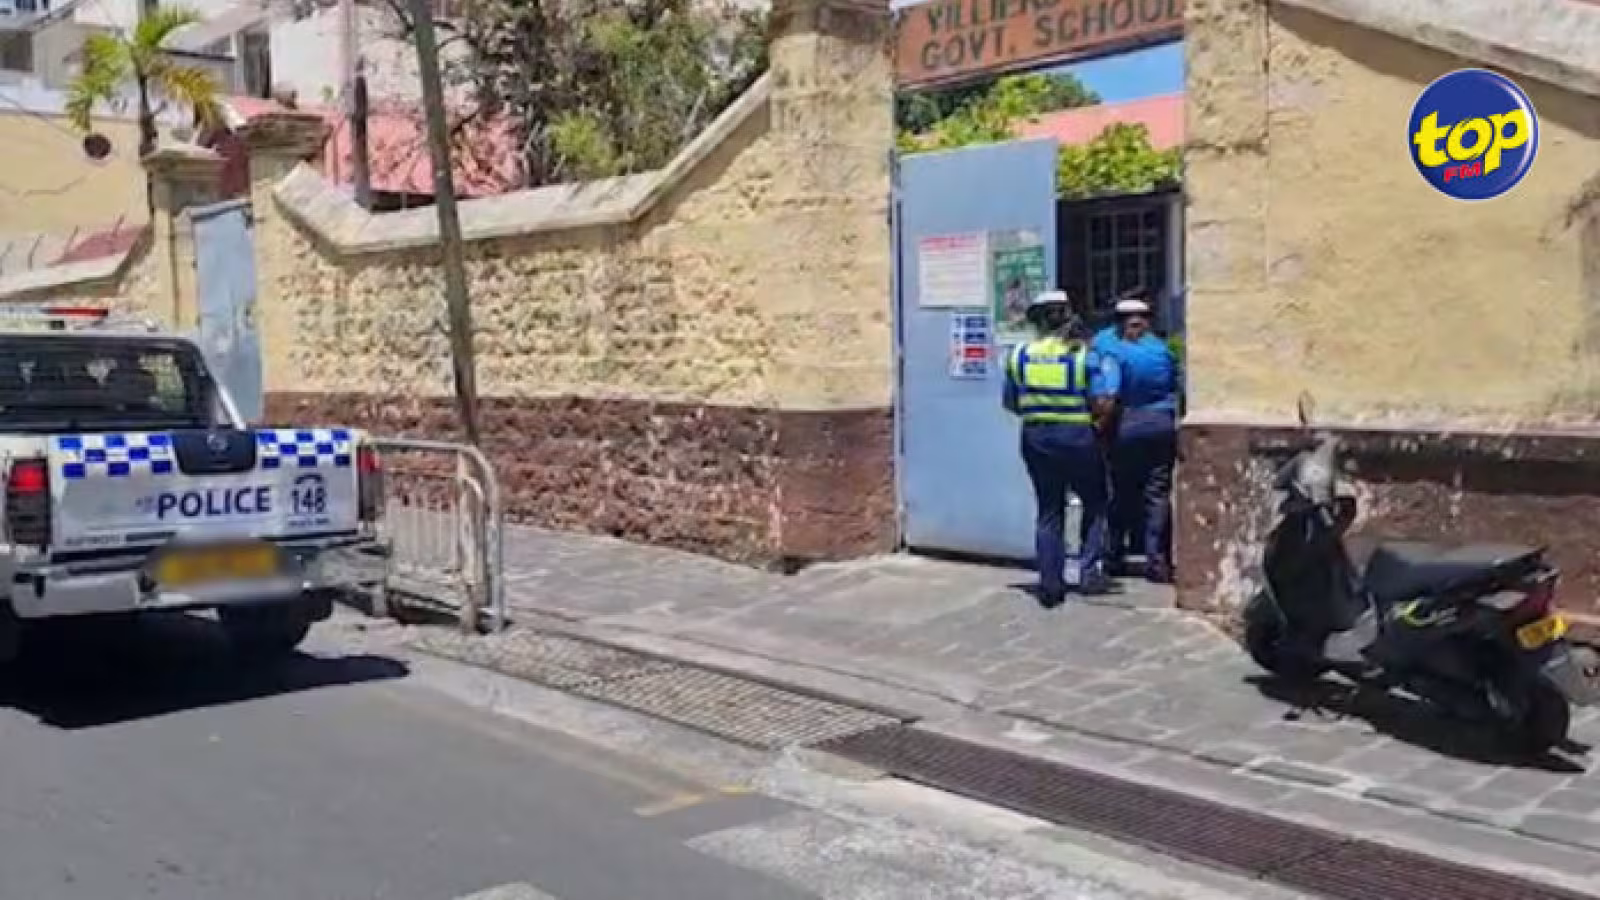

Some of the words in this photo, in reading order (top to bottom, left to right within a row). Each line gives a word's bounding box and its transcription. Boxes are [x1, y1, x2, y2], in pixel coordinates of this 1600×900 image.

[921, 25, 1017, 69] GOVT.
[1033, 0, 1184, 46] SCHOOL
[157, 486, 271, 520] POLICE
[291, 487, 328, 514] 148
